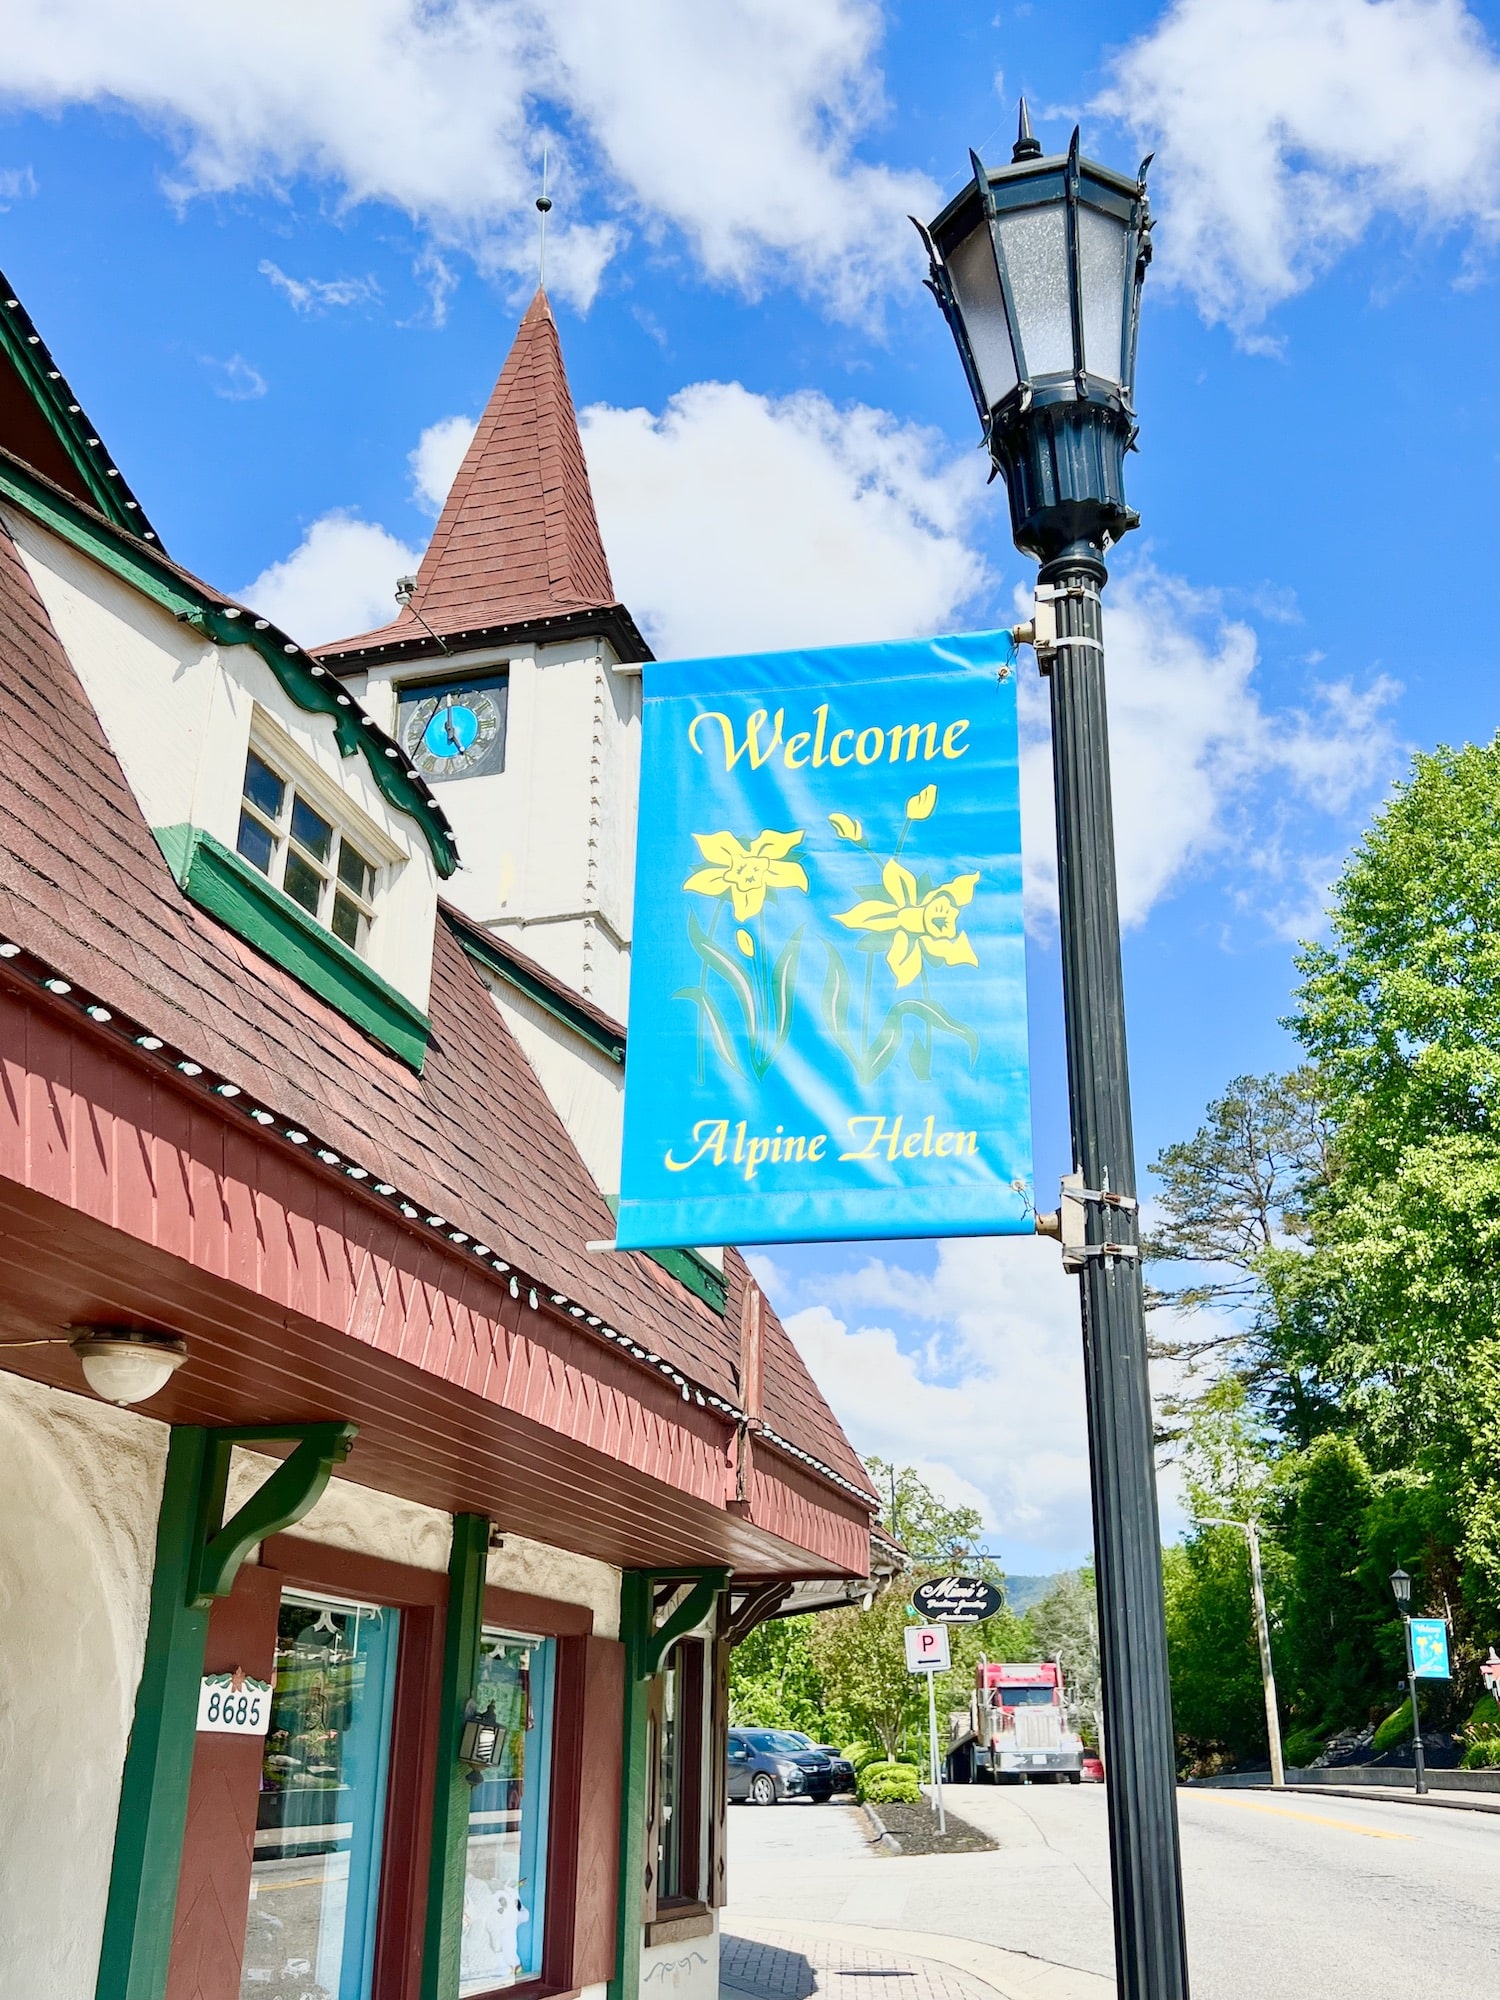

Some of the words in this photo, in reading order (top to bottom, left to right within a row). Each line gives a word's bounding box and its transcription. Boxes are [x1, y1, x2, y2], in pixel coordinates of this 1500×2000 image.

[688, 703, 970, 771] Welcome
[664, 1119, 827, 1179] Alpine
[838, 1115, 979, 1161] Helen
[922, 1635, 934, 1652] P
[207, 1692, 262, 1726] 8685
